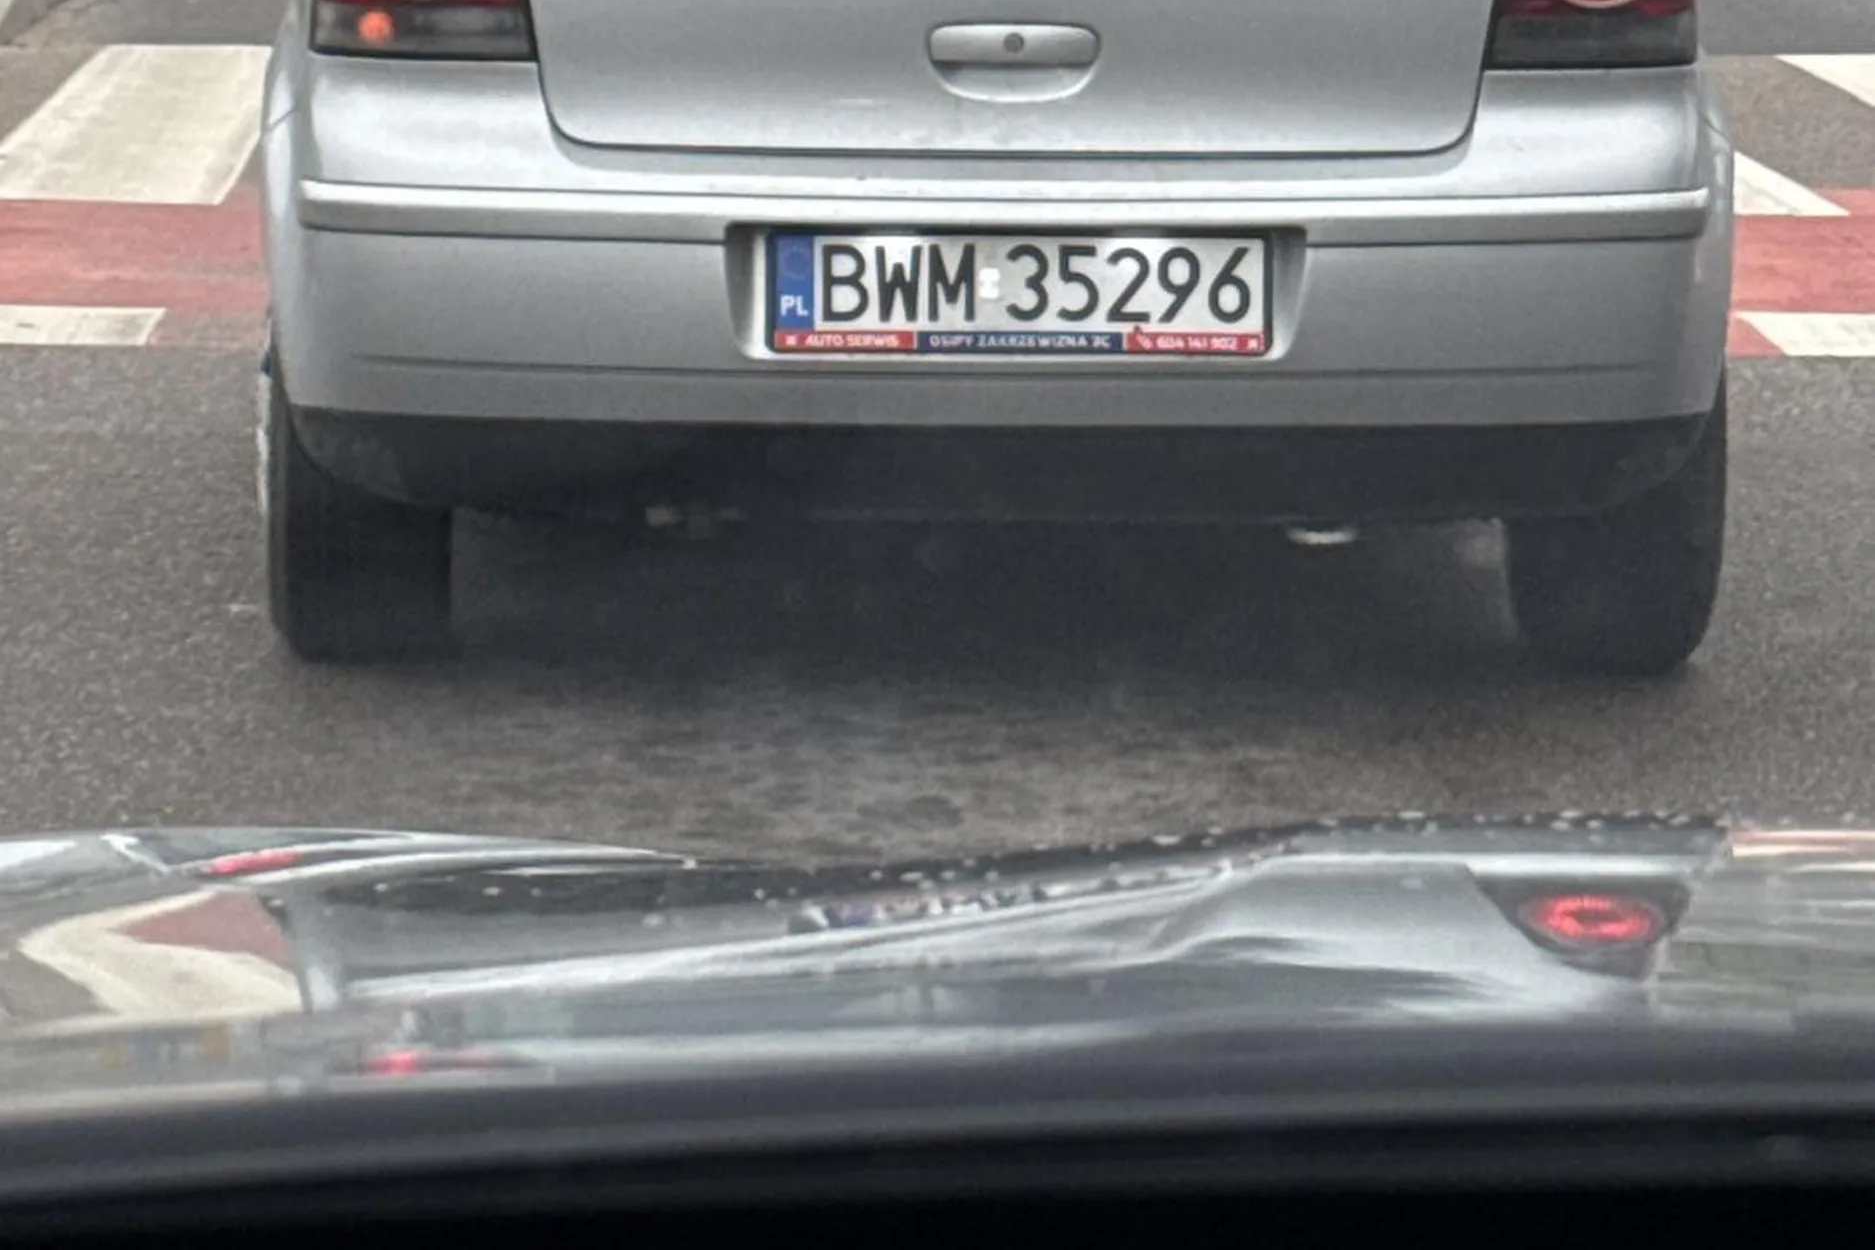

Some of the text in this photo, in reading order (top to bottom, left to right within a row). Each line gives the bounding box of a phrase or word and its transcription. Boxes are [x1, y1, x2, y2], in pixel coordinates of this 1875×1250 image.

[822, 243, 1251, 324] BWM 35296
[780, 294, 809, 317] PL
[804, 333, 901, 348] AUTO SERWIS
